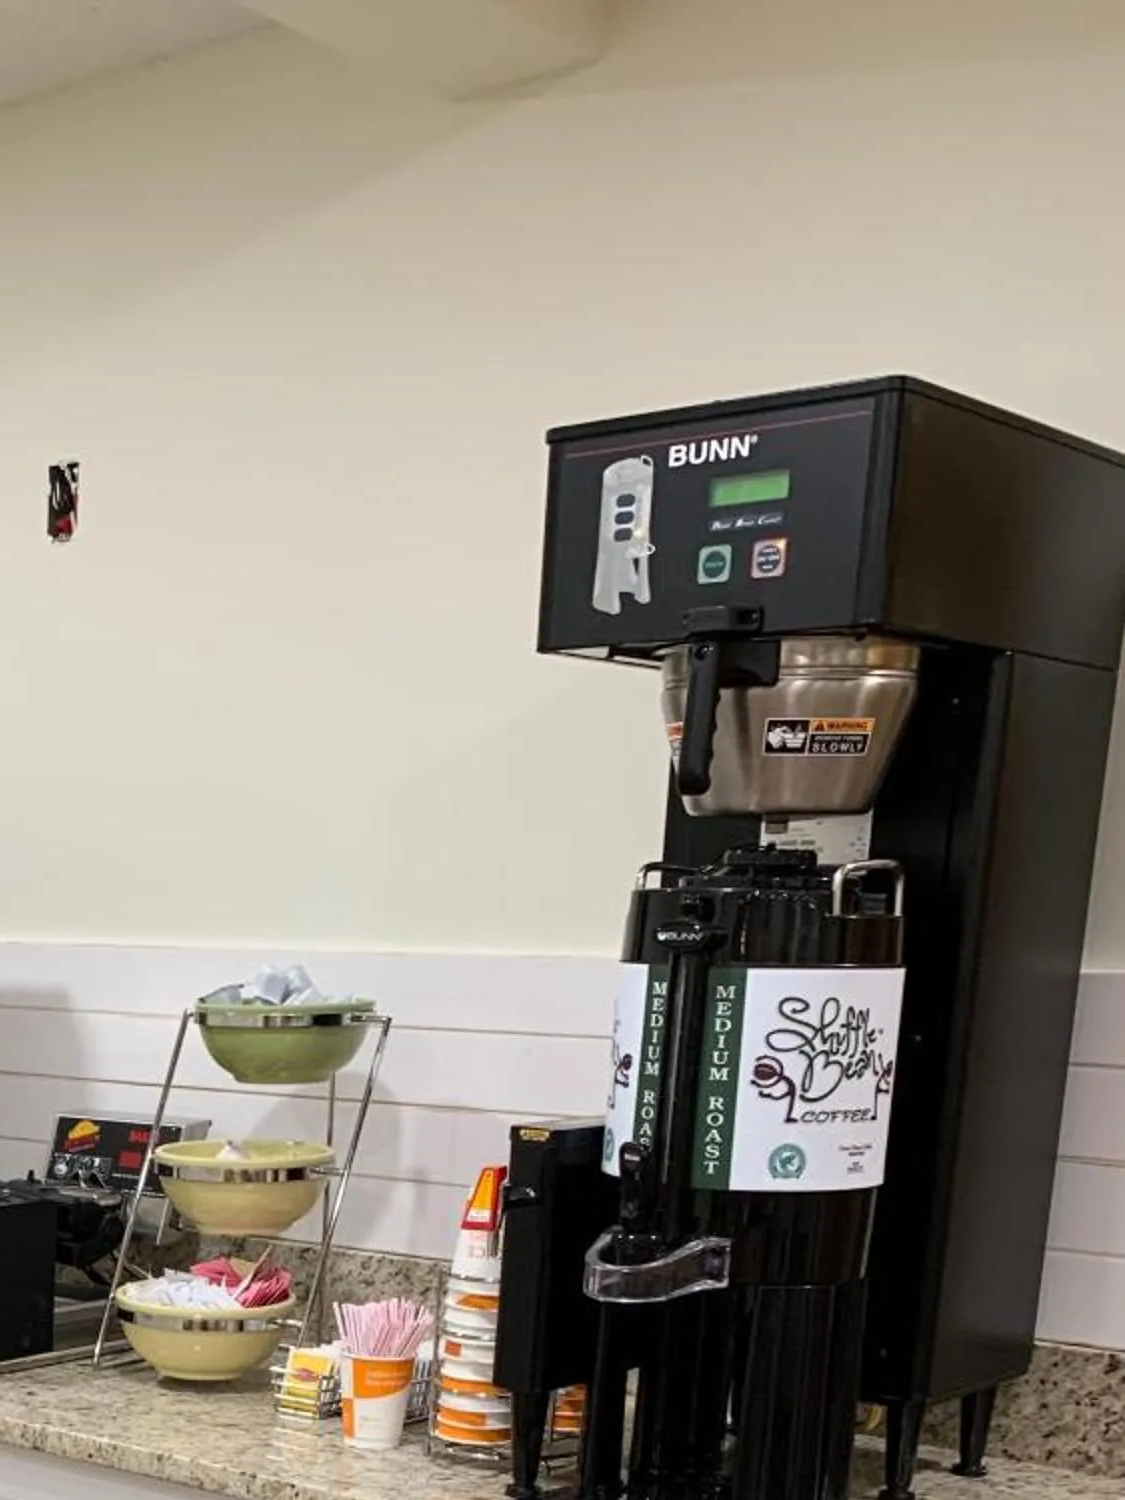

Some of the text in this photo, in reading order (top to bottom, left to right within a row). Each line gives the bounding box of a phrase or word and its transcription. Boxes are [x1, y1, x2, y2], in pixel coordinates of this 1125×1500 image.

[668, 434, 751, 468] BUNN
[812, 742, 863, 753] SLOWLY
[639, 982, 668, 1146] MEDIUM ROAS
[703, 985, 737, 1175] MEDIUM ROAST
[800, 1108, 872, 1123] COFFEE
